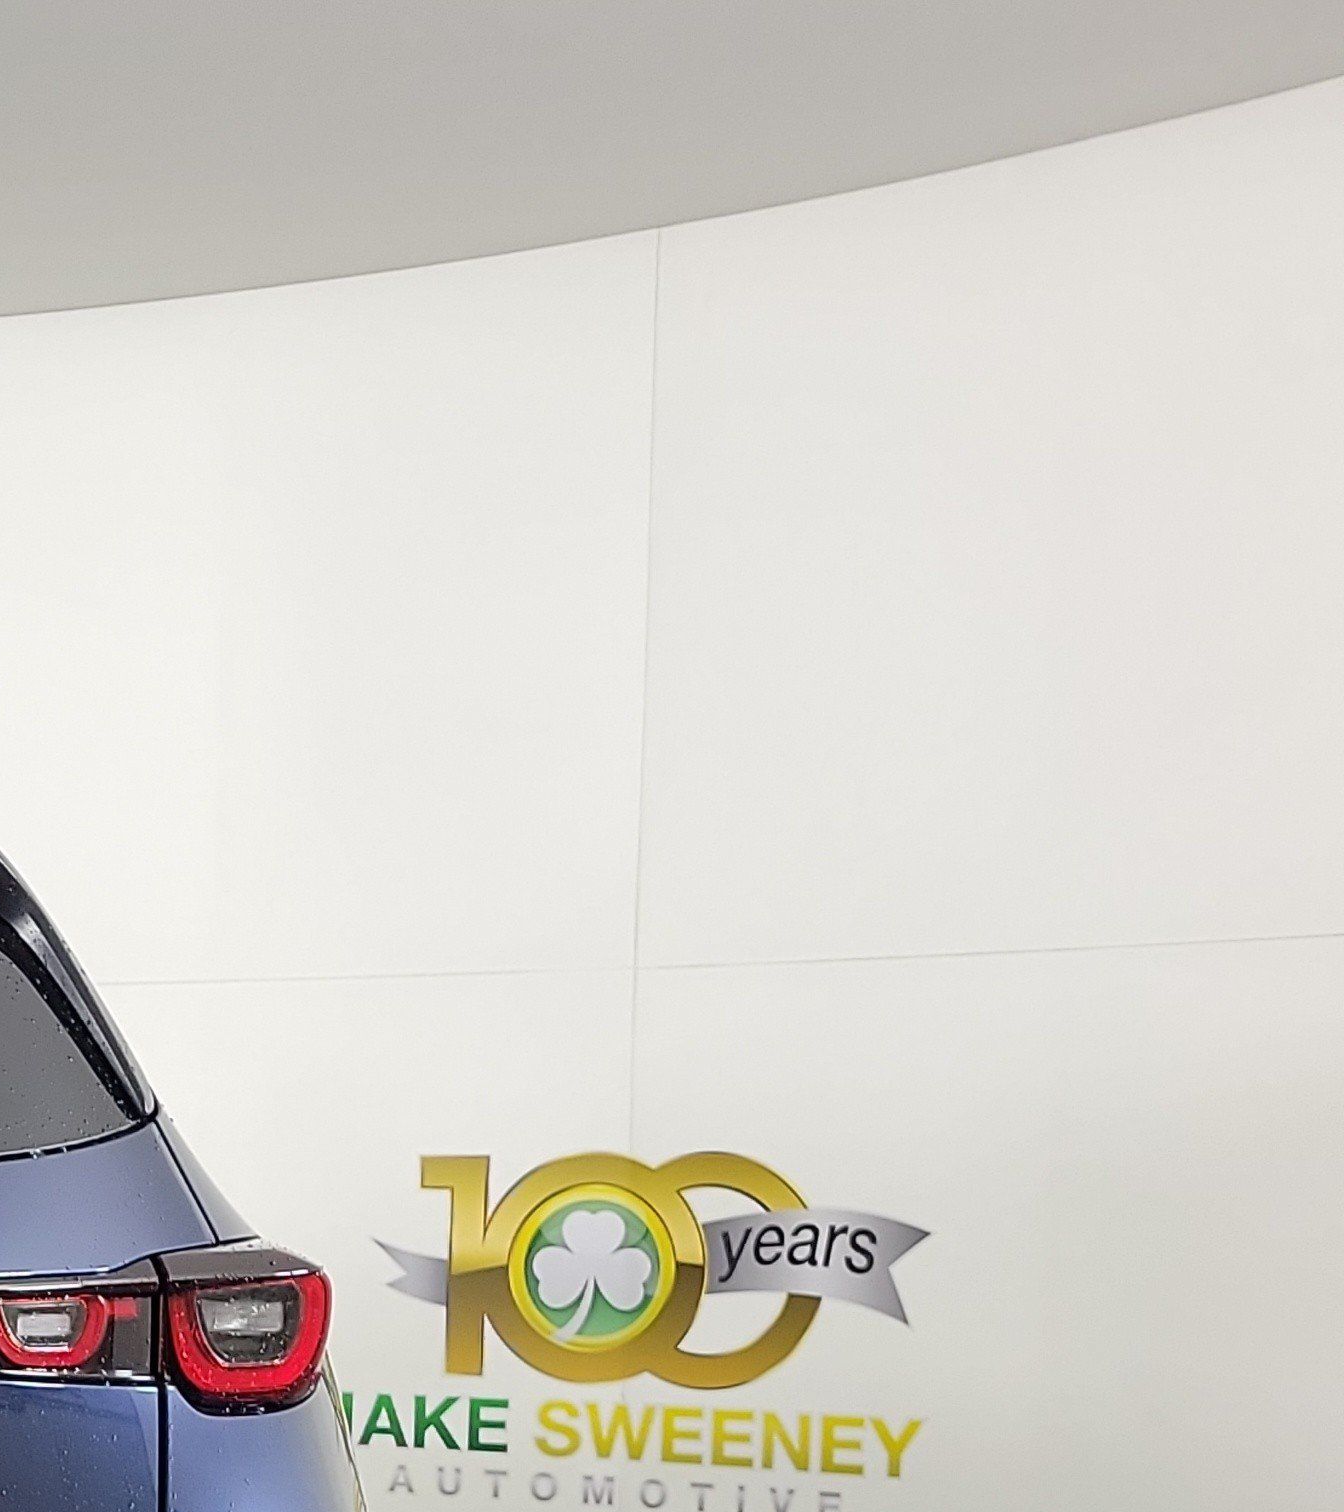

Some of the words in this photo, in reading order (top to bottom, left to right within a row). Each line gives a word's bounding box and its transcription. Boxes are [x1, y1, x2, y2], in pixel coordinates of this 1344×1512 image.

[420, 1151, 823, 1391] 100
[717, 1218, 879, 1283] years
[533, 1399, 923, 1479] SWEENEY
